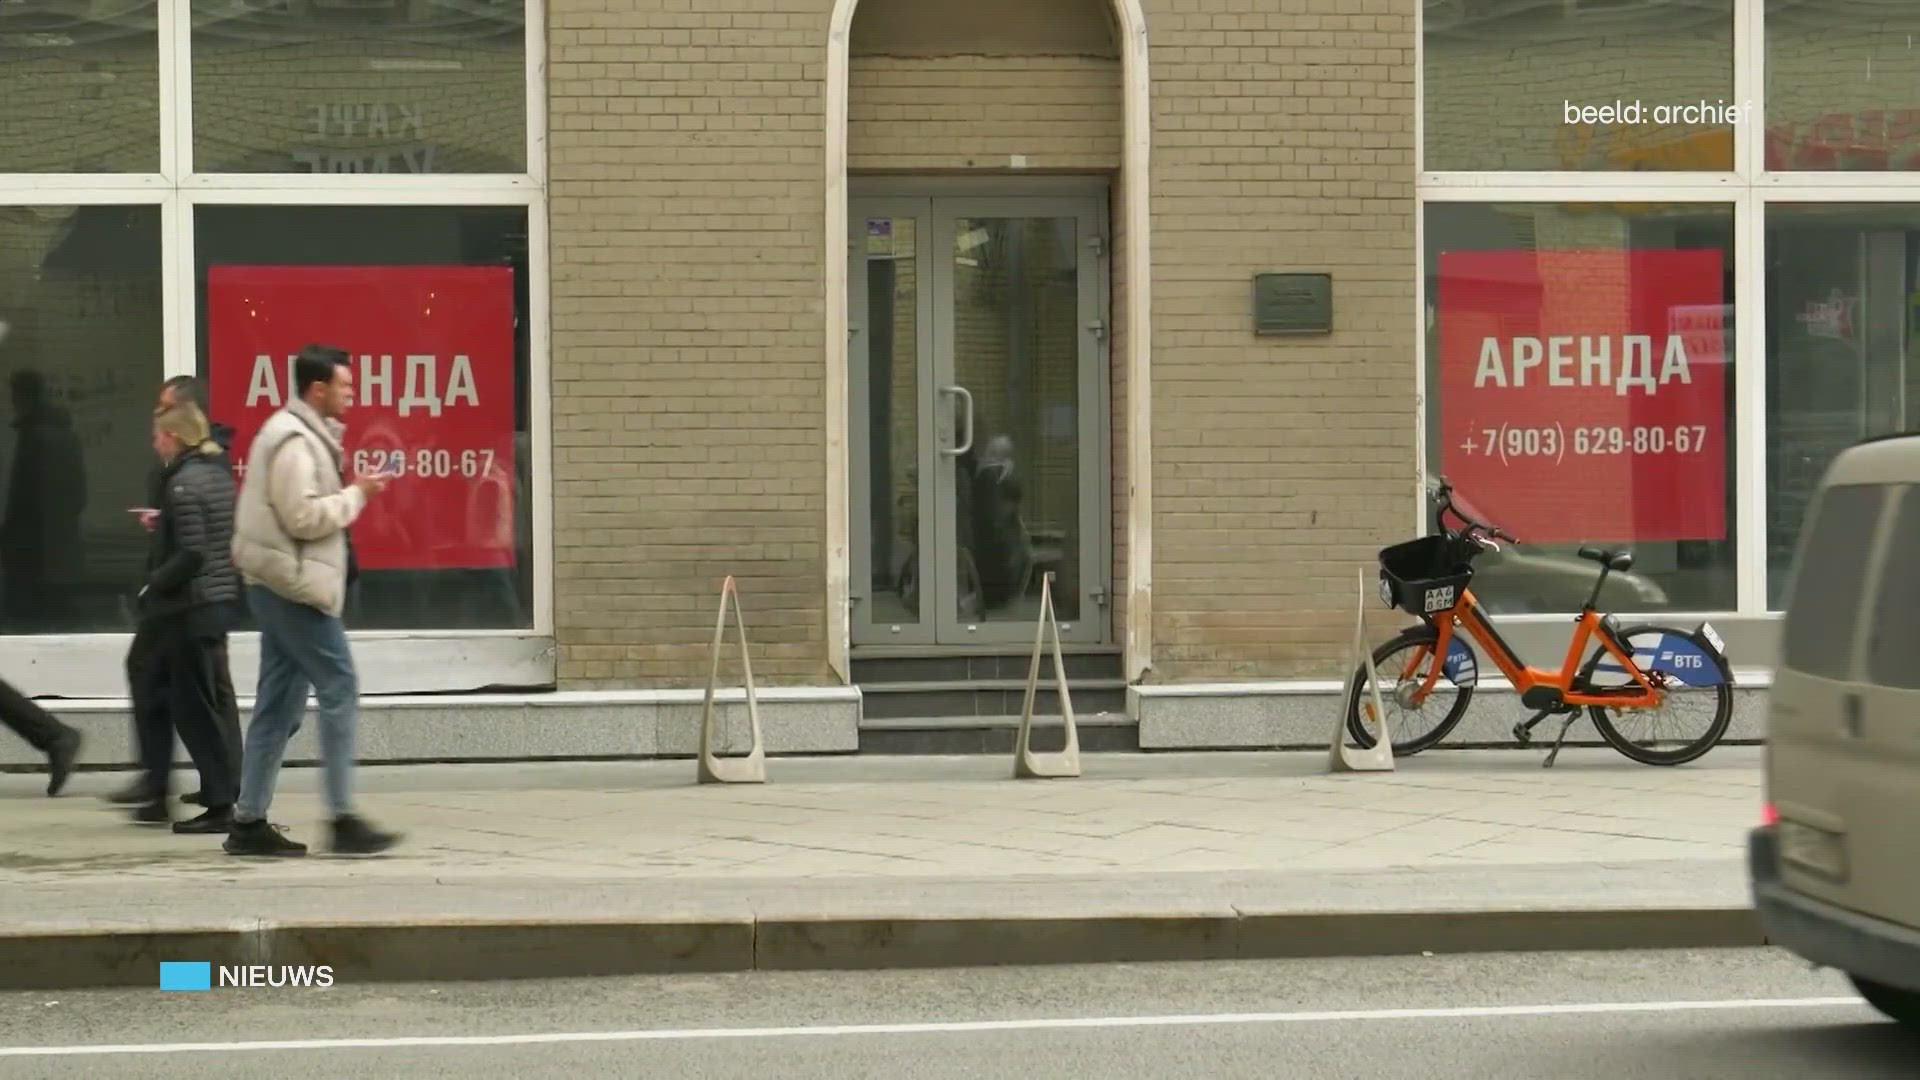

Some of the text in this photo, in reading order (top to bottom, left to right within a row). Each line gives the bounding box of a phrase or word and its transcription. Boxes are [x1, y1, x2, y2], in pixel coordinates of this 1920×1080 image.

[246, 355, 479, 417] АНДА
[1474, 335, 1692, 396] АРЕНДА
[1460, 421, 1706, 466] +7(903) 629-80-67
[1674, 654, 1703, 668] ВТБ
